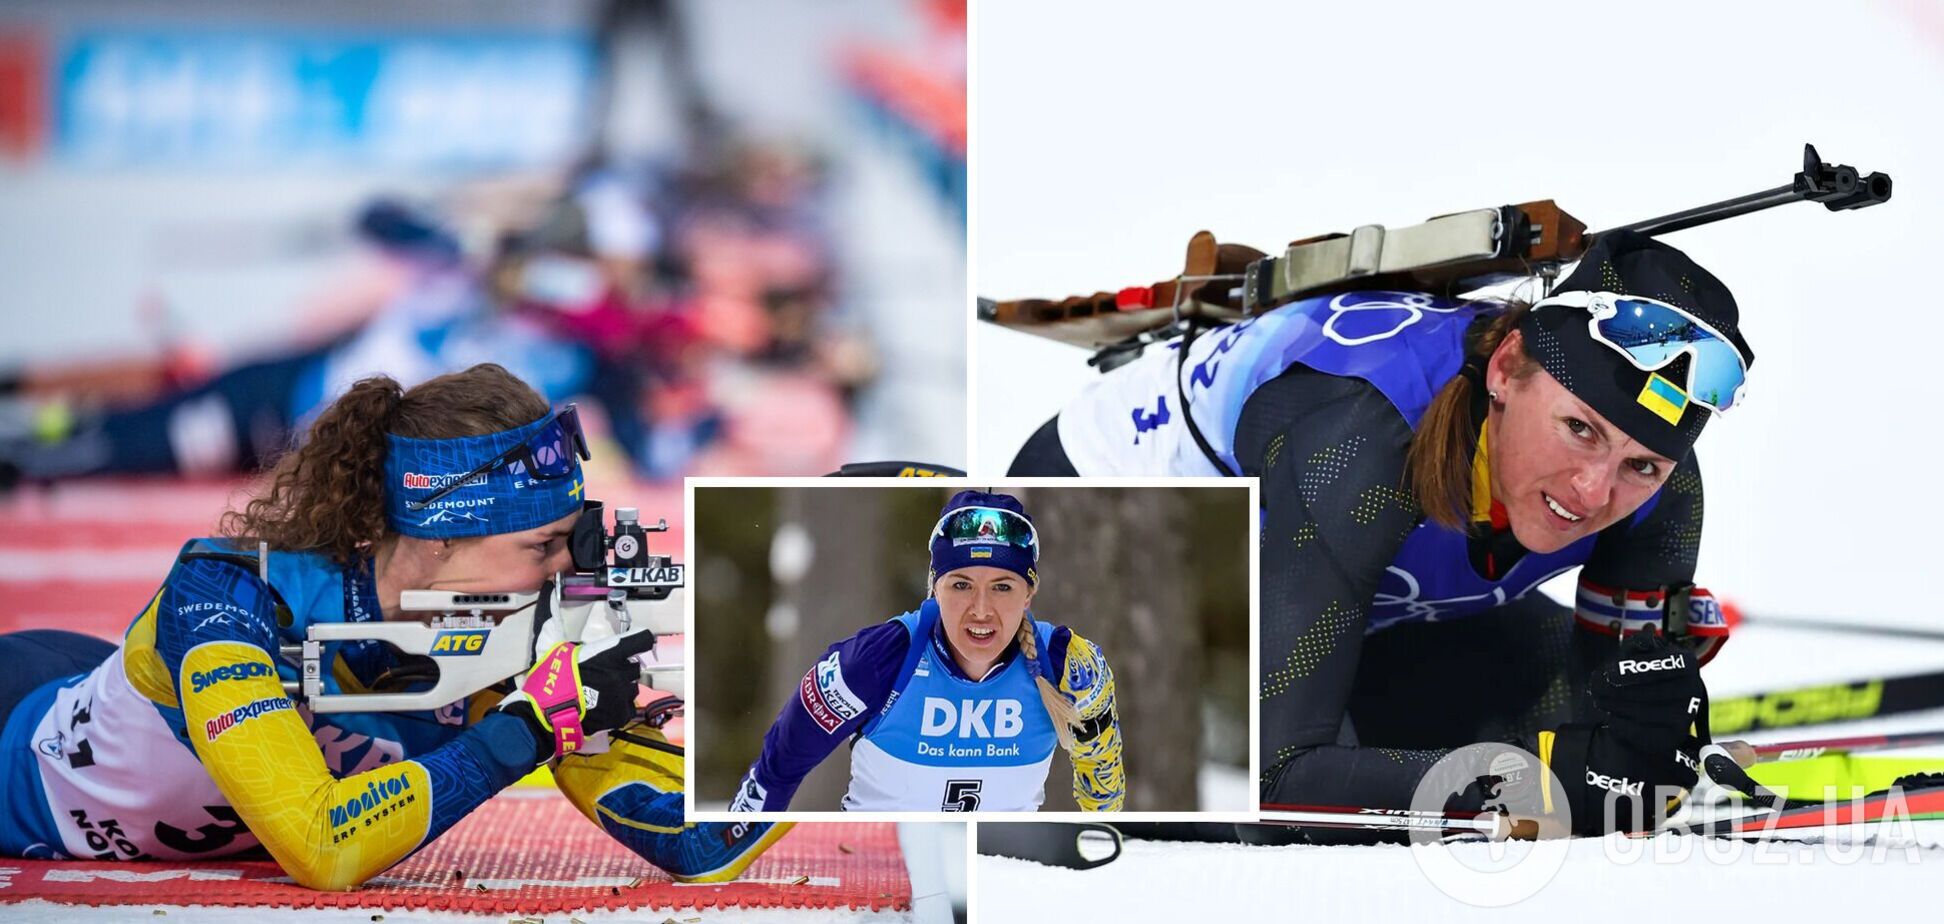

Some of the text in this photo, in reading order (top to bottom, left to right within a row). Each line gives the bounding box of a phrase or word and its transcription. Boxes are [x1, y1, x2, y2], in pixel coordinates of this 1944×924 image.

[630, 568, 679, 583] LKAB
[433, 634, 485, 651] ATG
[191, 661, 274, 693] Swegon
[543, 645, 569, 695] LEKI
[824, 689, 852, 718] KELA
[921, 697, 1024, 738] DKB
[918, 742, 1020, 757] Das kann Bank
[941, 779, 983, 812] 5
[333, 794, 416, 843] ERP SYSTEM
